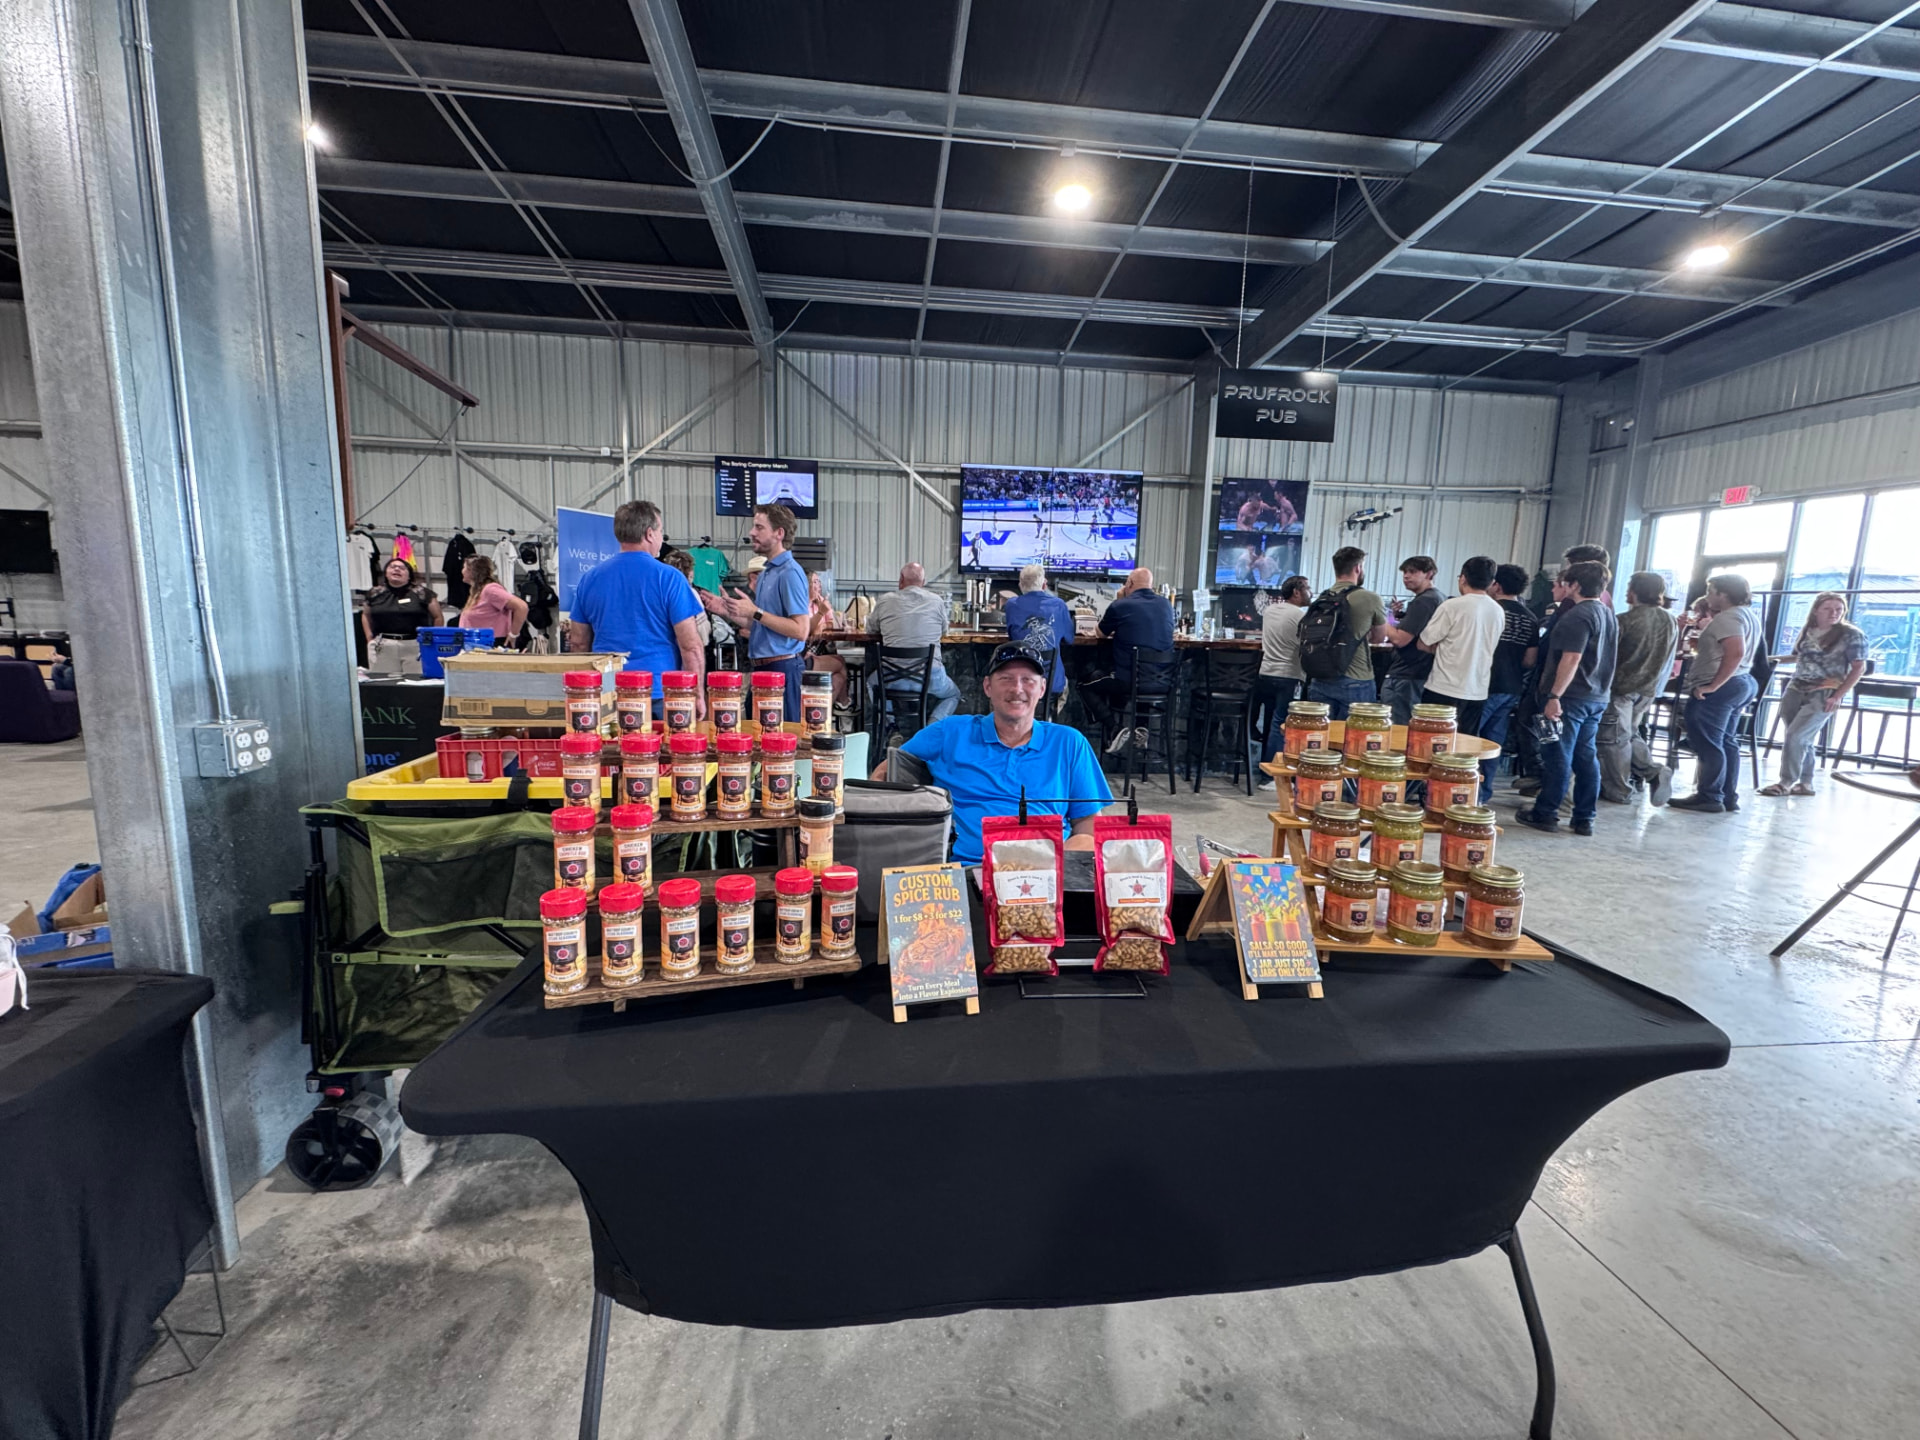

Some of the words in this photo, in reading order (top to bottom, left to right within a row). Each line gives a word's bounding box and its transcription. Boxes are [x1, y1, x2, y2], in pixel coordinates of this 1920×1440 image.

[1224, 384, 1331, 404] PRUFROCK
[1256, 408, 1298, 424] PUB
[1725, 487, 1748, 504] EXIT
[568, 547, 598, 560] We're
[899, 873, 952, 890] CUSTOM
[894, 888, 930, 907] SPICE
[934, 887, 961, 902] RUB
[894, 915, 899, 923] 1
[899, 914, 912, 923] for
[912, 912, 923, 922] $8
[935, 911, 947, 919] for
[948, 909, 963, 919] $22
[1249, 941, 1273, 950] SALSA
[1274, 941, 1284, 950] SO
[1286, 940, 1307, 950] GOOD
[1253, 960, 1257, 968] 1
[1259, 959, 1272, 968] JAR
[1274, 959, 1290, 968] JUST
[1292, 958, 1305, 968] $10
[1252, 968, 1258, 977] 3
[1260, 968, 1277, 977] JARS
[1278, 968, 1295, 976] ONLY
[925, 982, 942, 991] Every
[944, 979, 960, 987] Meal
[918, 990, 940, 998] Flavor
[940, 987, 972, 997] Explosion
